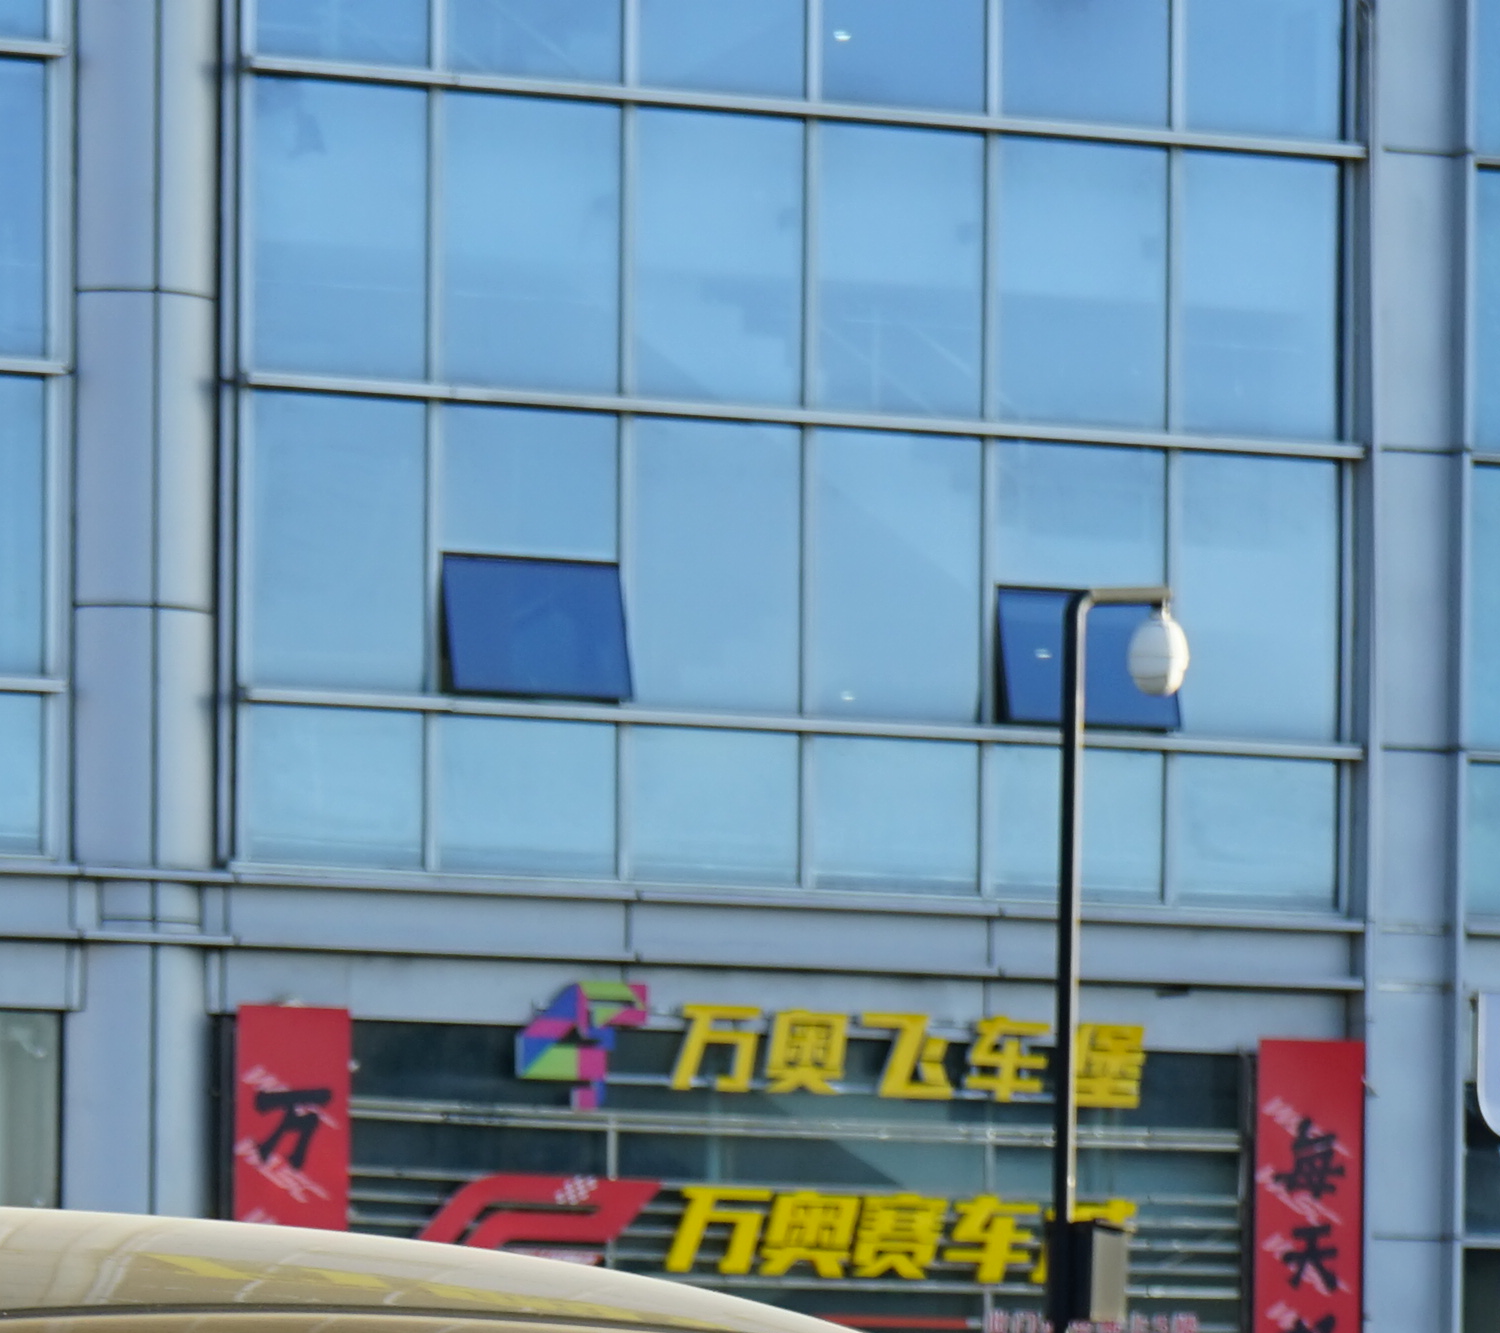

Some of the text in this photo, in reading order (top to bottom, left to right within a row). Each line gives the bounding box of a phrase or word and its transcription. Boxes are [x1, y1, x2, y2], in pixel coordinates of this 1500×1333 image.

[671, 1004, 1147, 1109] 万奥飞车堡
